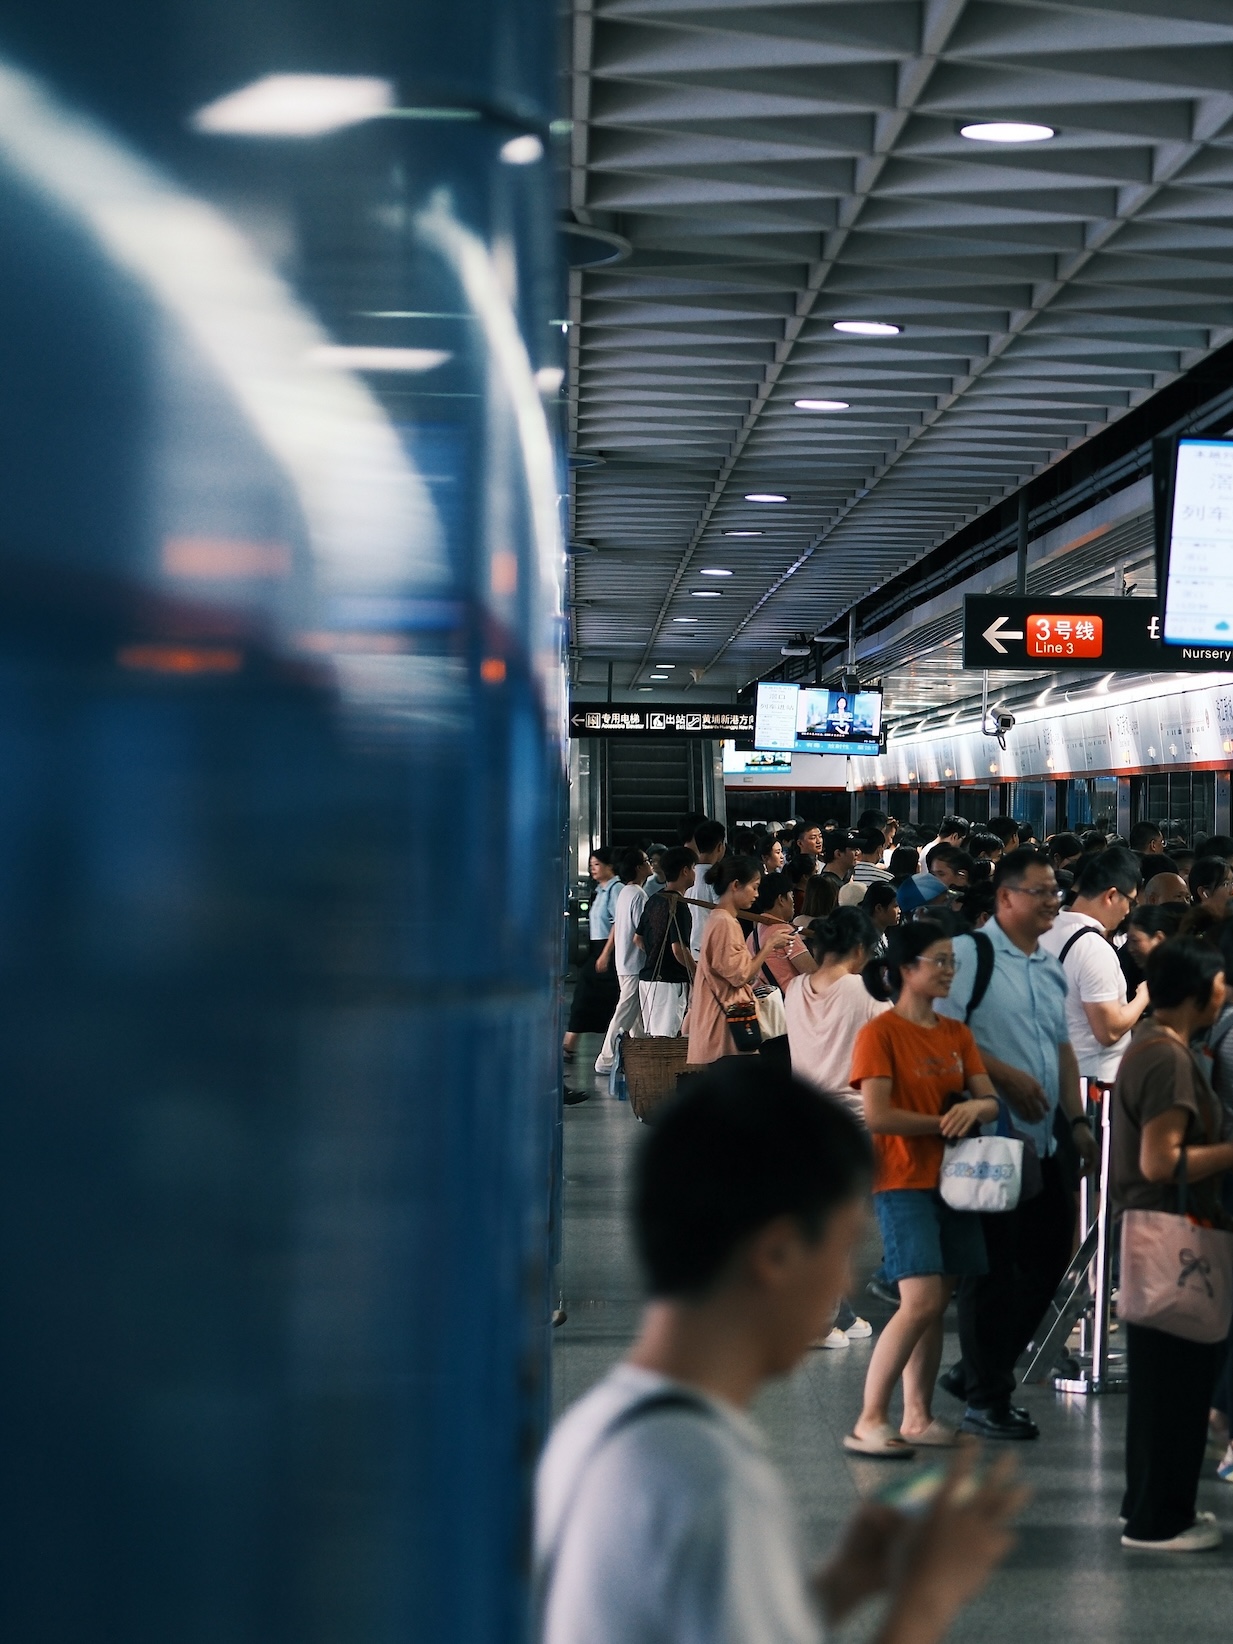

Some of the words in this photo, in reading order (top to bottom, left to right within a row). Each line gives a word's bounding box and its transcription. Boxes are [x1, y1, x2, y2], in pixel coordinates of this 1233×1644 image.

[1035, 618, 1095, 641] 3号线
[1035, 641, 1062, 654] Line
[1066, 642, 1074, 654] 3
[1183, 647, 1232, 662] Nursery
[601, 713, 640, 724] 专用电梯
[666, 713, 686, 725] 出站
